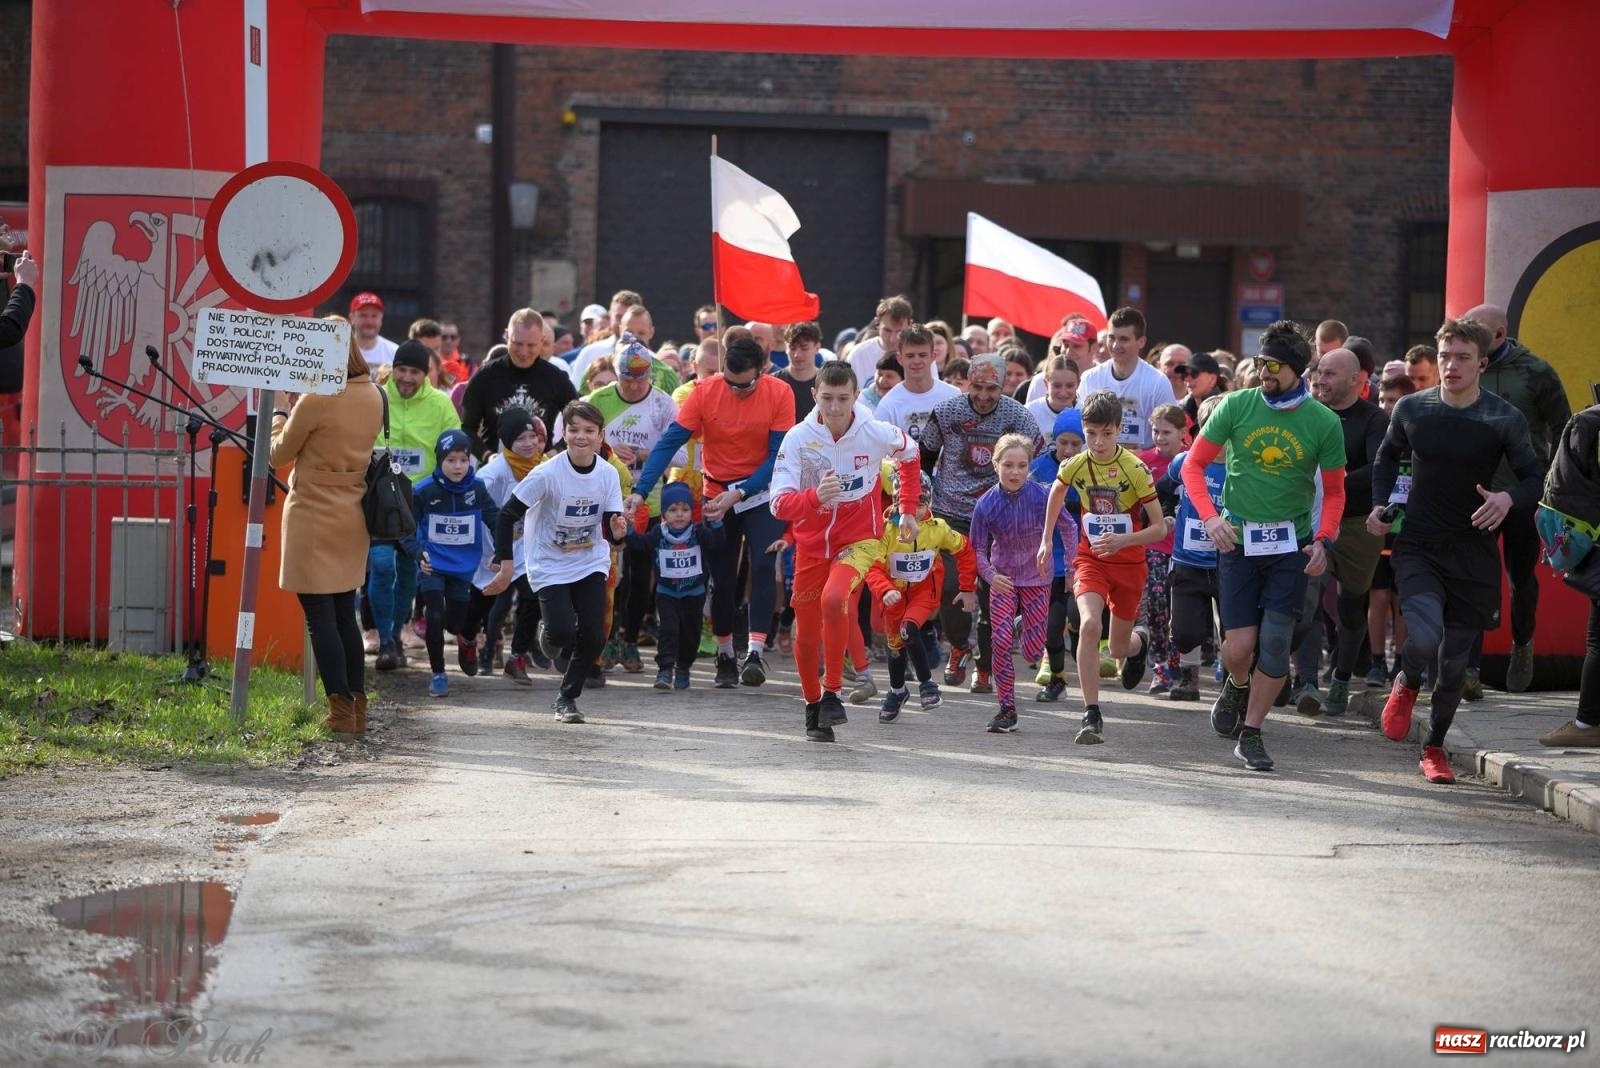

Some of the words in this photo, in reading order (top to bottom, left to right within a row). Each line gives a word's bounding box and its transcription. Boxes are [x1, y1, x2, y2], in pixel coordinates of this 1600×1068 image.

[208, 312, 225, 322] NIE
[230, 314, 275, 327] DOTYCZY
[281, 319, 337, 333] POJAZDÓW
[283, 332, 308, 345] PPO,
[206, 337, 282, 352] DOSTAWCZYCH
[295, 346, 324, 358] ORAZ
[196, 349, 262, 363] PRYWATNYCH
[202, 361, 281, 378] PRACOWNIKÓW
[321, 374, 343, 385] PPO
[609, 430, 649, 441] AKTYWNI
[397, 455, 410, 465] 62
[1398, 484, 1410, 494] 55
[575, 506, 590, 516] 44
[445, 524, 459, 534] 63
[1099, 524, 1115, 535] 29
[1261, 529, 1278, 542] 56
[672, 557, 692, 568] 101
[906, 561, 922, 572] 68
